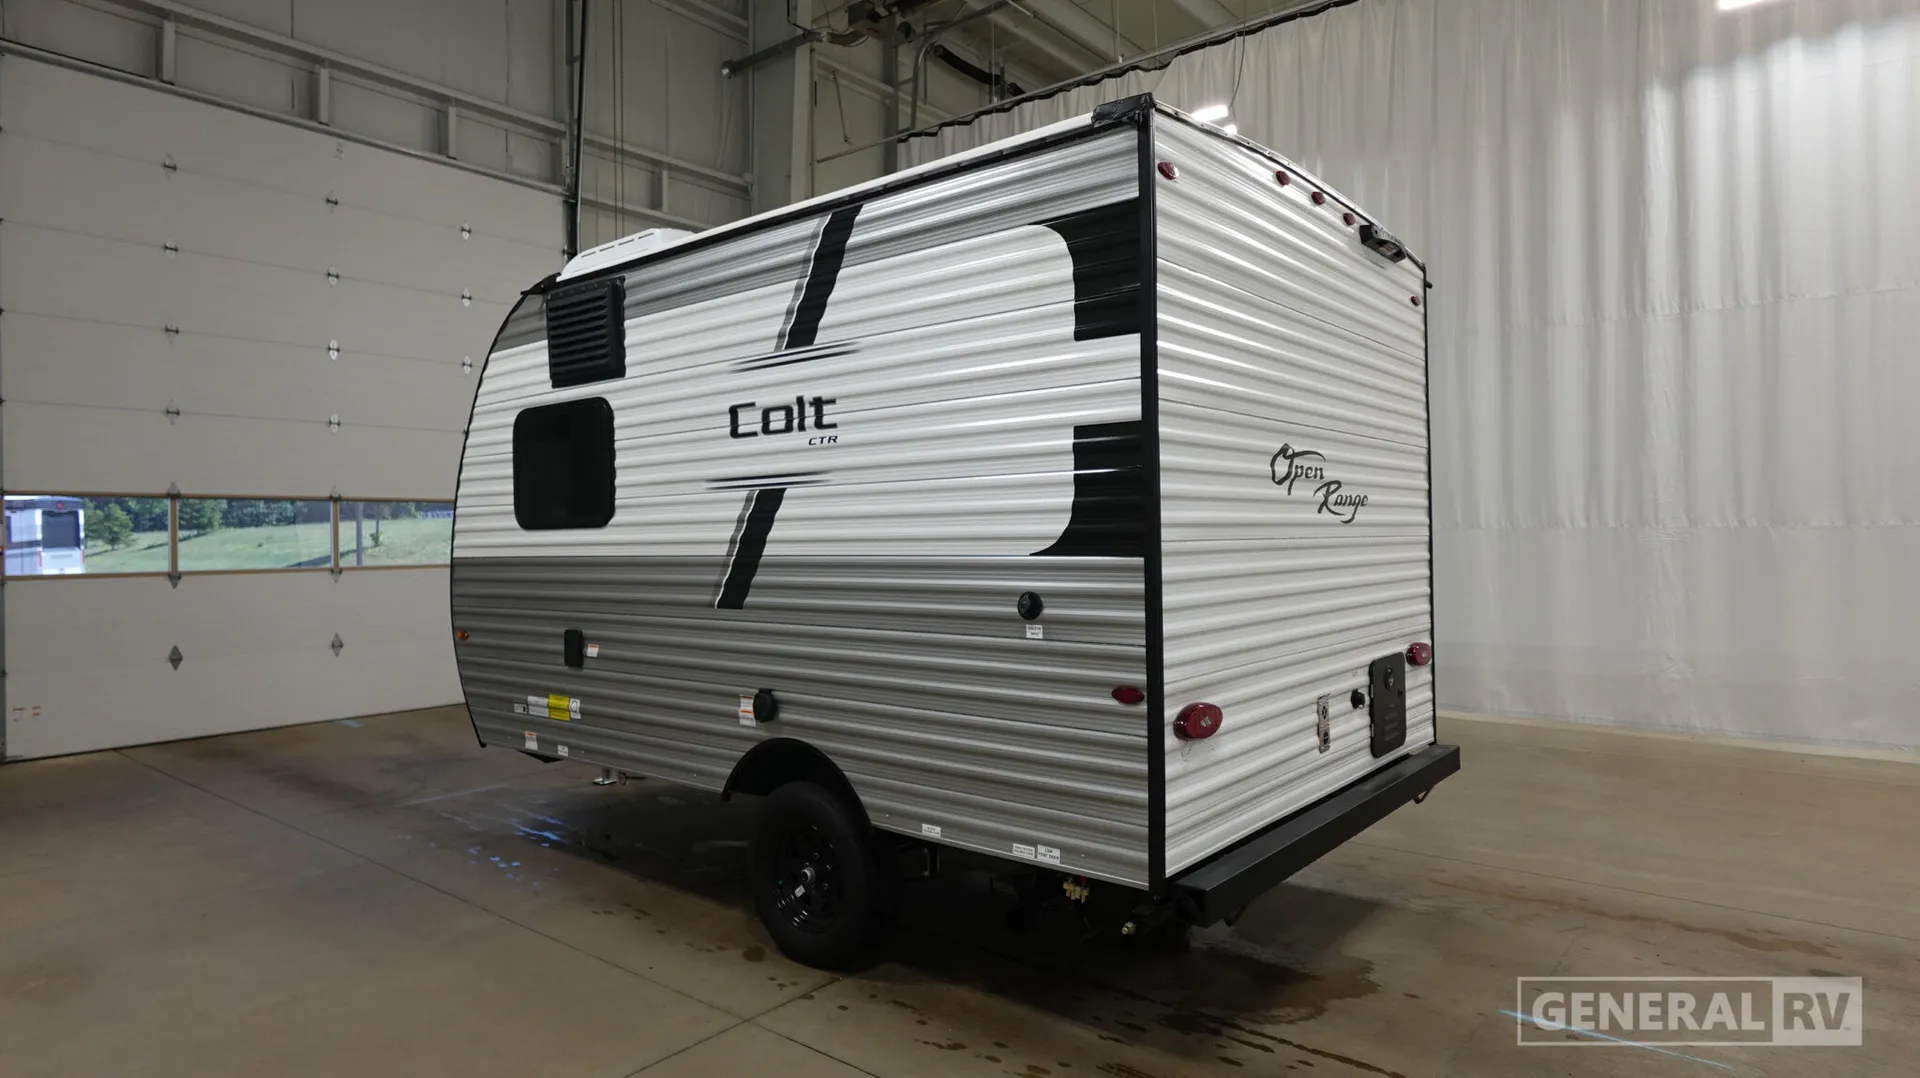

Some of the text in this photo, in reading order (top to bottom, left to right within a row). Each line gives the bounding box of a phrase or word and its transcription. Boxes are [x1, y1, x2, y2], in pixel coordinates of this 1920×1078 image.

[728, 395, 838, 439] Colt
[808, 435, 838, 446] CTR
[1270, 443, 1326, 496] Open
[1313, 480, 1369, 524] Range
